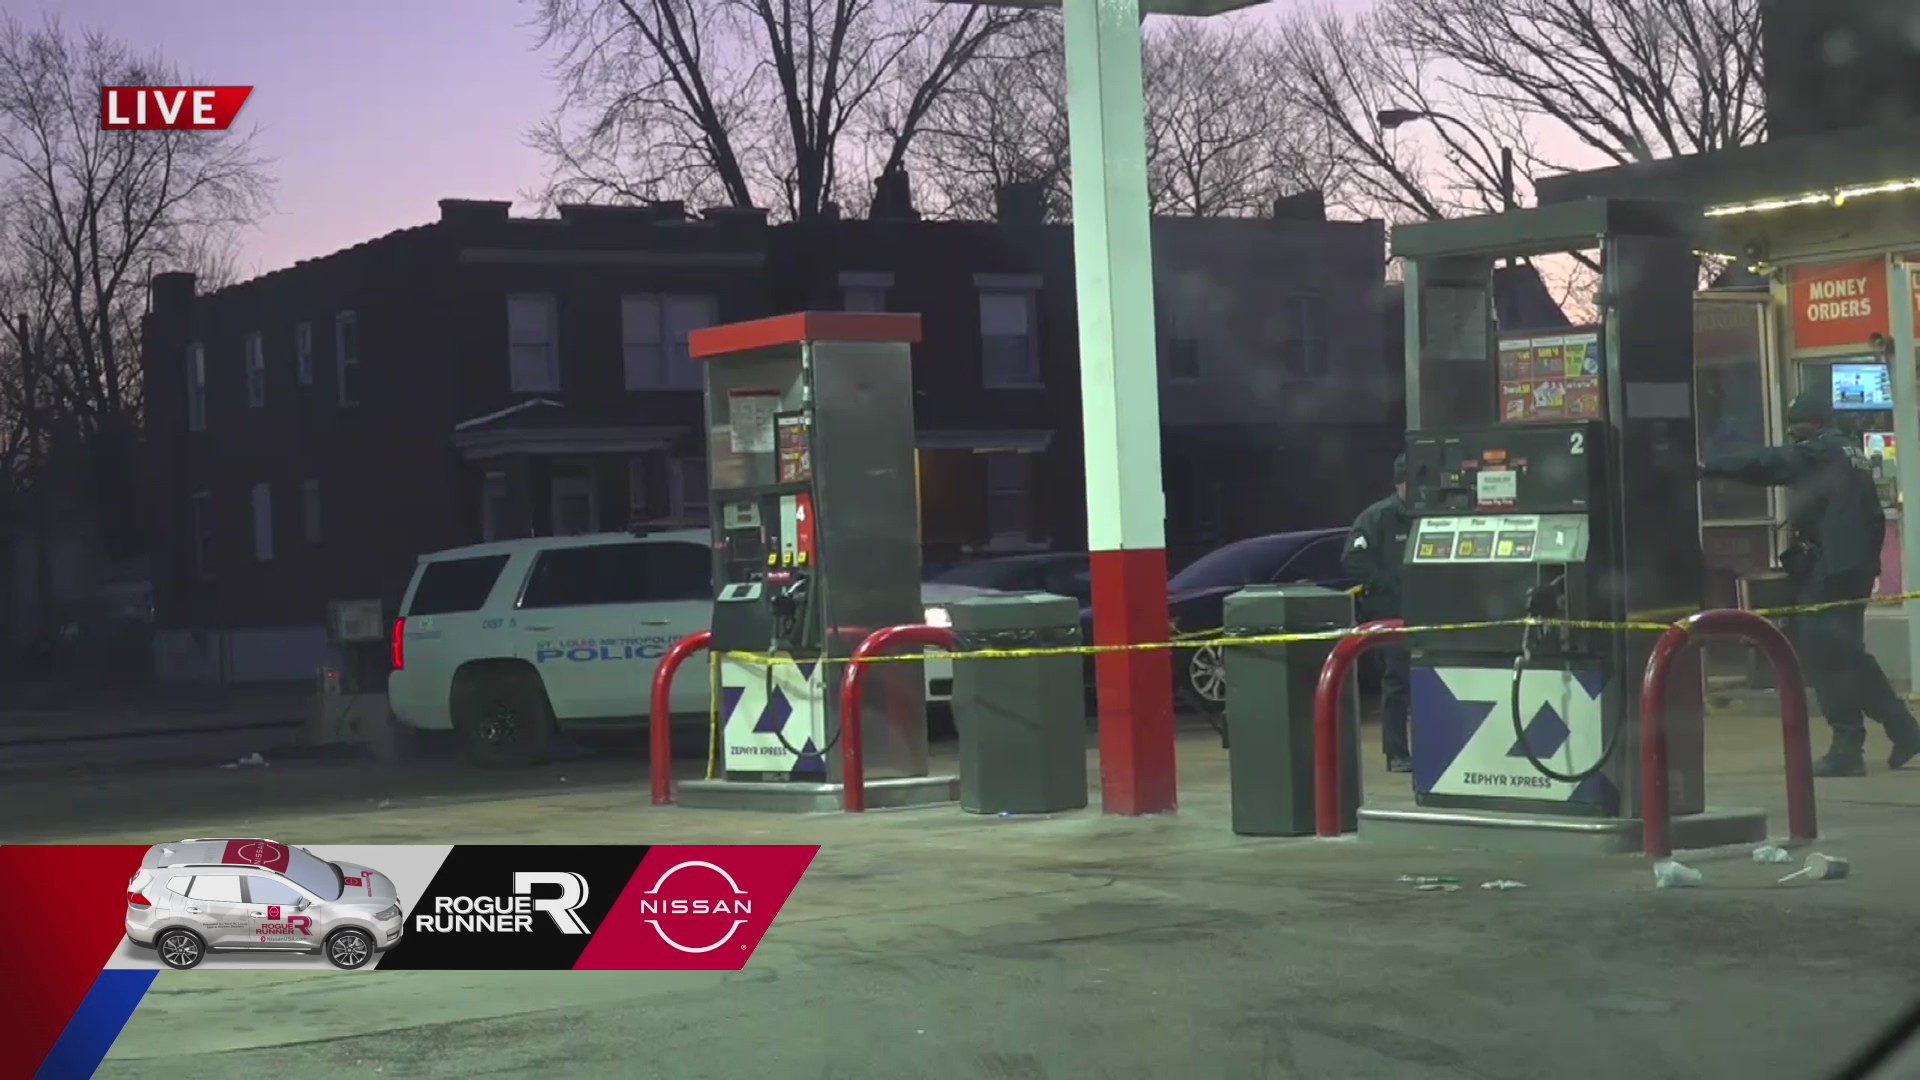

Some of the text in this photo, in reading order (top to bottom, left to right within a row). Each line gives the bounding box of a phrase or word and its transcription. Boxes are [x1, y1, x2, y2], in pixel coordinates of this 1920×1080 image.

[1809, 277, 1867, 301] MONEY
[1807, 298, 1872, 322] ORDERS
[1570, 433, 1584, 455] 2
[796, 505, 805, 522] 4
[559, 638, 596, 648] LOUIS
[600, 634, 684, 647] METROPOLIT
[536, 645, 668, 664] POLIC
[730, 745, 787, 757] ZEPHYR XPRESS
[1463, 772, 1552, 789] ZEPHYR XPRESS
